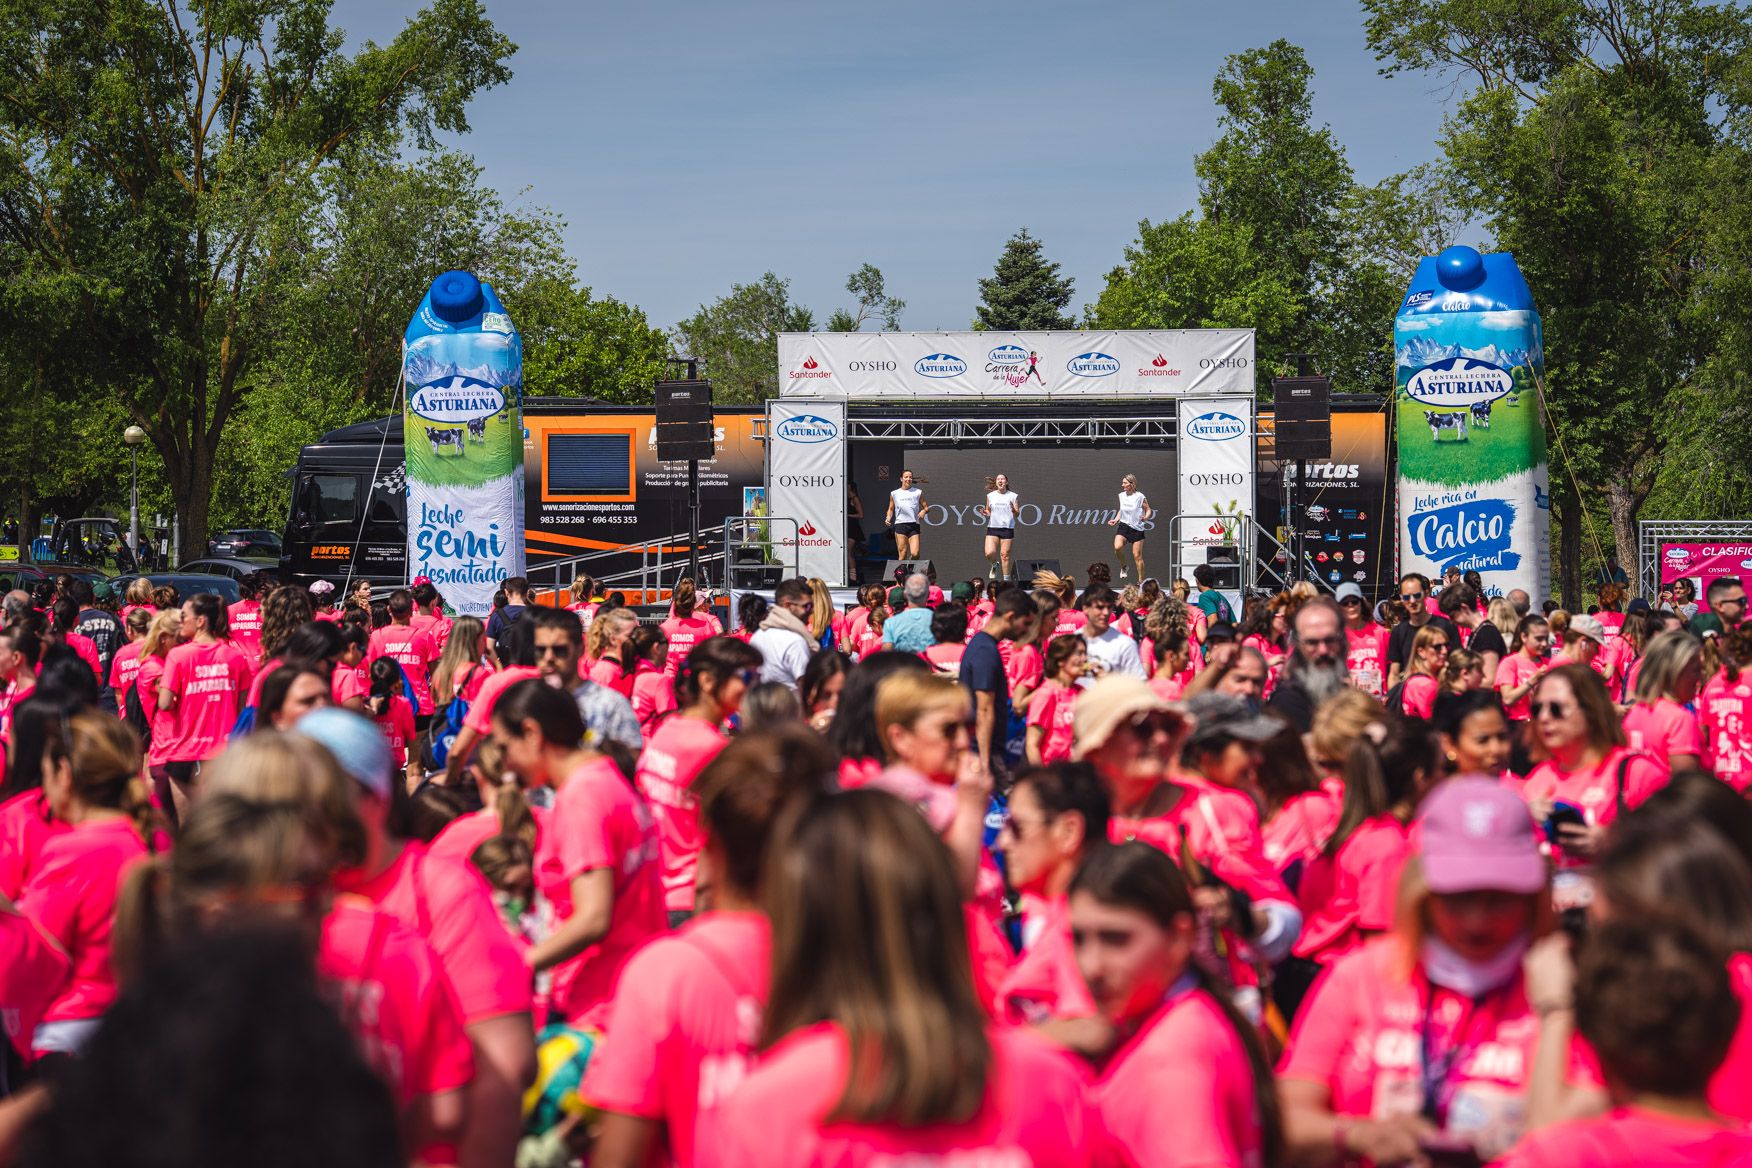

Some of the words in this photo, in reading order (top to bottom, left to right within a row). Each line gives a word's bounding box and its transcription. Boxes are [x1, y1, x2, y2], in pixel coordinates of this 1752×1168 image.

[1442, 301, 1471, 312] Calcio
[991, 352, 1026, 360] ASTURIANA
[849, 360, 897, 372] OYSHO
[919, 362, 963, 372] ASTURIANA
[985, 362, 1019, 374] Carrera
[1071, 361, 1117, 371] ASTURIANA
[1199, 358, 1248, 369] OYSHO
[789, 371, 832, 379] Santander
[1138, 368, 1181, 377] Santander
[1005, 372, 1030, 387] Mujer
[1413, 377, 1505, 396] ASTURIANA
[416, 393, 498, 412] ASTURIANA
[781, 425, 833, 436] ASTURIANA
[1191, 422, 1241, 434] ASTURIANA
[780, 475, 834, 487] OYSHO
[1190, 473, 1243, 485] OYSHO
[1413, 494, 1439, 512] Leche
[1442, 492, 1461, 505] rica
[1465, 490, 1477, 500] en
[542, 502, 635, 513] www.sonorizacionesportos.com
[418, 502, 465, 531] Leche
[540, 516, 554, 524] 983
[555, 516, 570, 524] 528
[570, 516, 585, 524] 268
[592, 516, 607, 524] 696
[607, 516, 622, 524] 455
[623, 516, 638, 524] 353
[923, 503, 1043, 526] OYSO
[1047, 504, 1158, 531] Runng
[1417, 511, 1503, 555] Calcio
[416, 523, 507, 561] semi
[1192, 537, 1241, 546] Santae
[311, 545, 350, 556] portos
[1454, 550, 1503, 571] natural
[417, 559, 508, 584] desnatada
[236, 613, 257, 621] SOMOS
[671, 633, 694, 643] SOMOS
[385, 643, 412, 653] SOMOS
[195, 663, 229, 678] SOMOS
